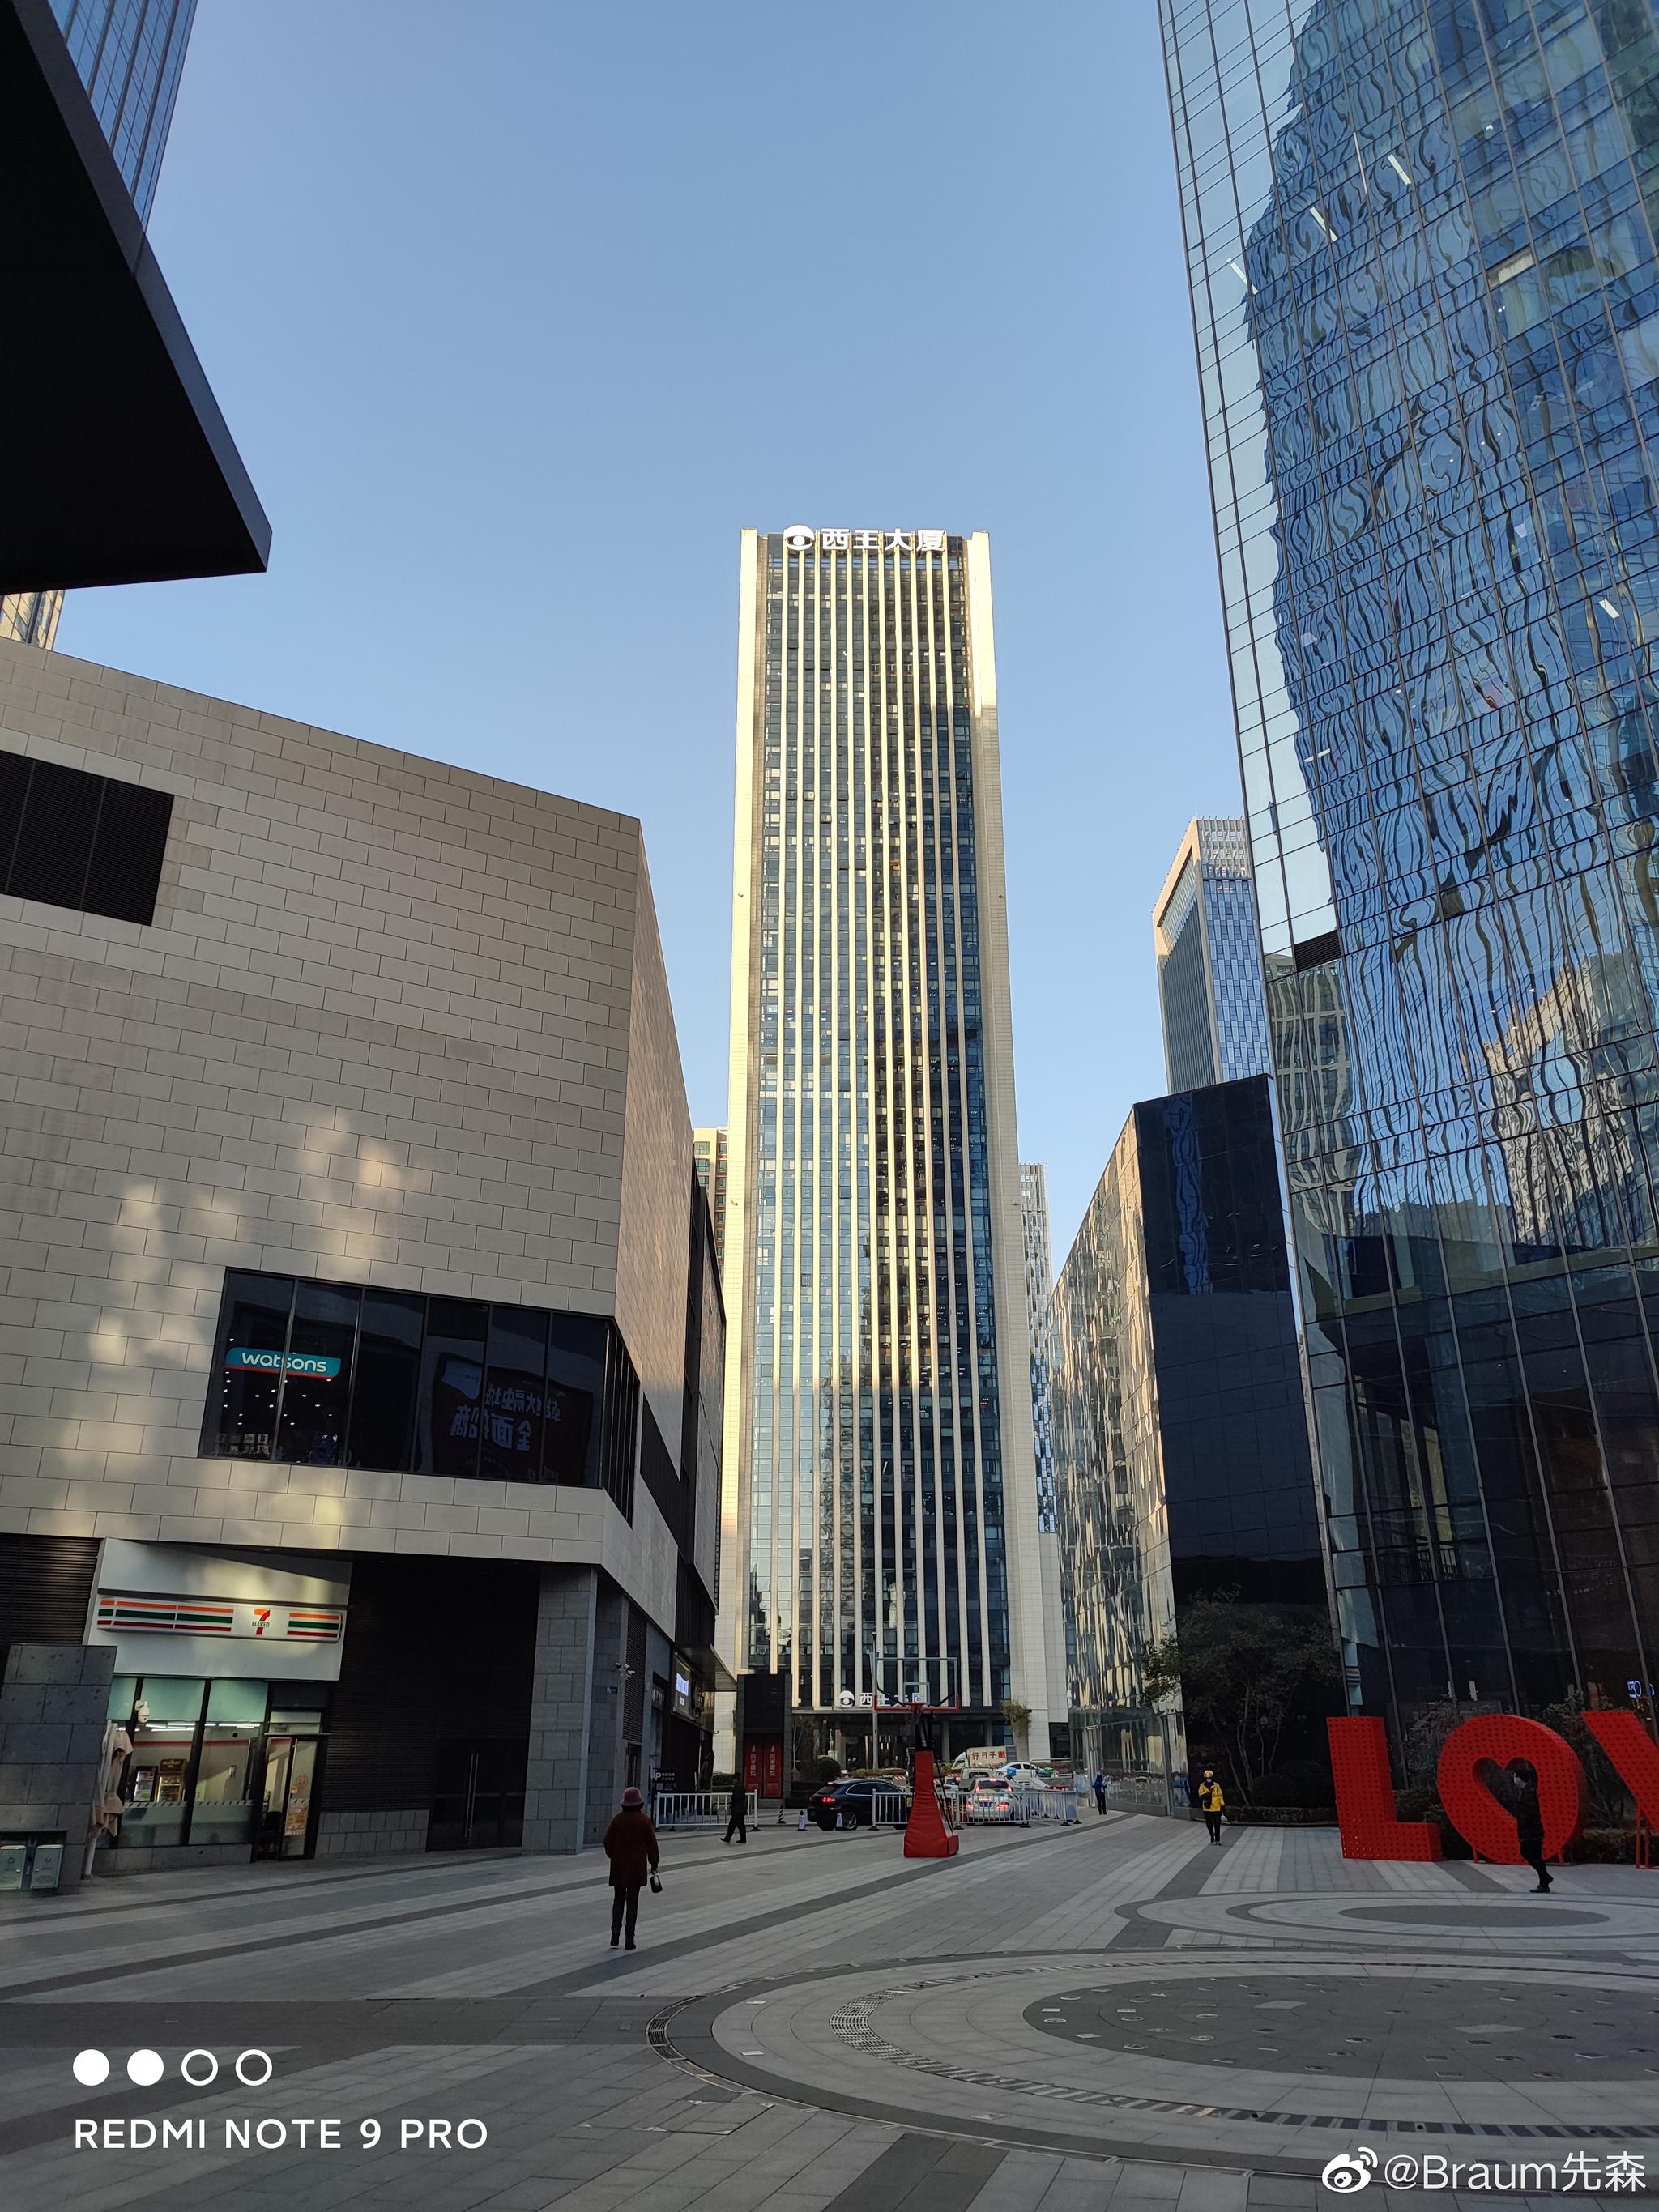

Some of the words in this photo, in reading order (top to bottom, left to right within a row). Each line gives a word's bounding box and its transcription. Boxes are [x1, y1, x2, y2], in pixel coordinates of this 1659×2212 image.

[821, 528, 945, 552] 西王大厦
[241, 1352, 327, 1373] watsons
[254, 1609, 271, 1635] 7
